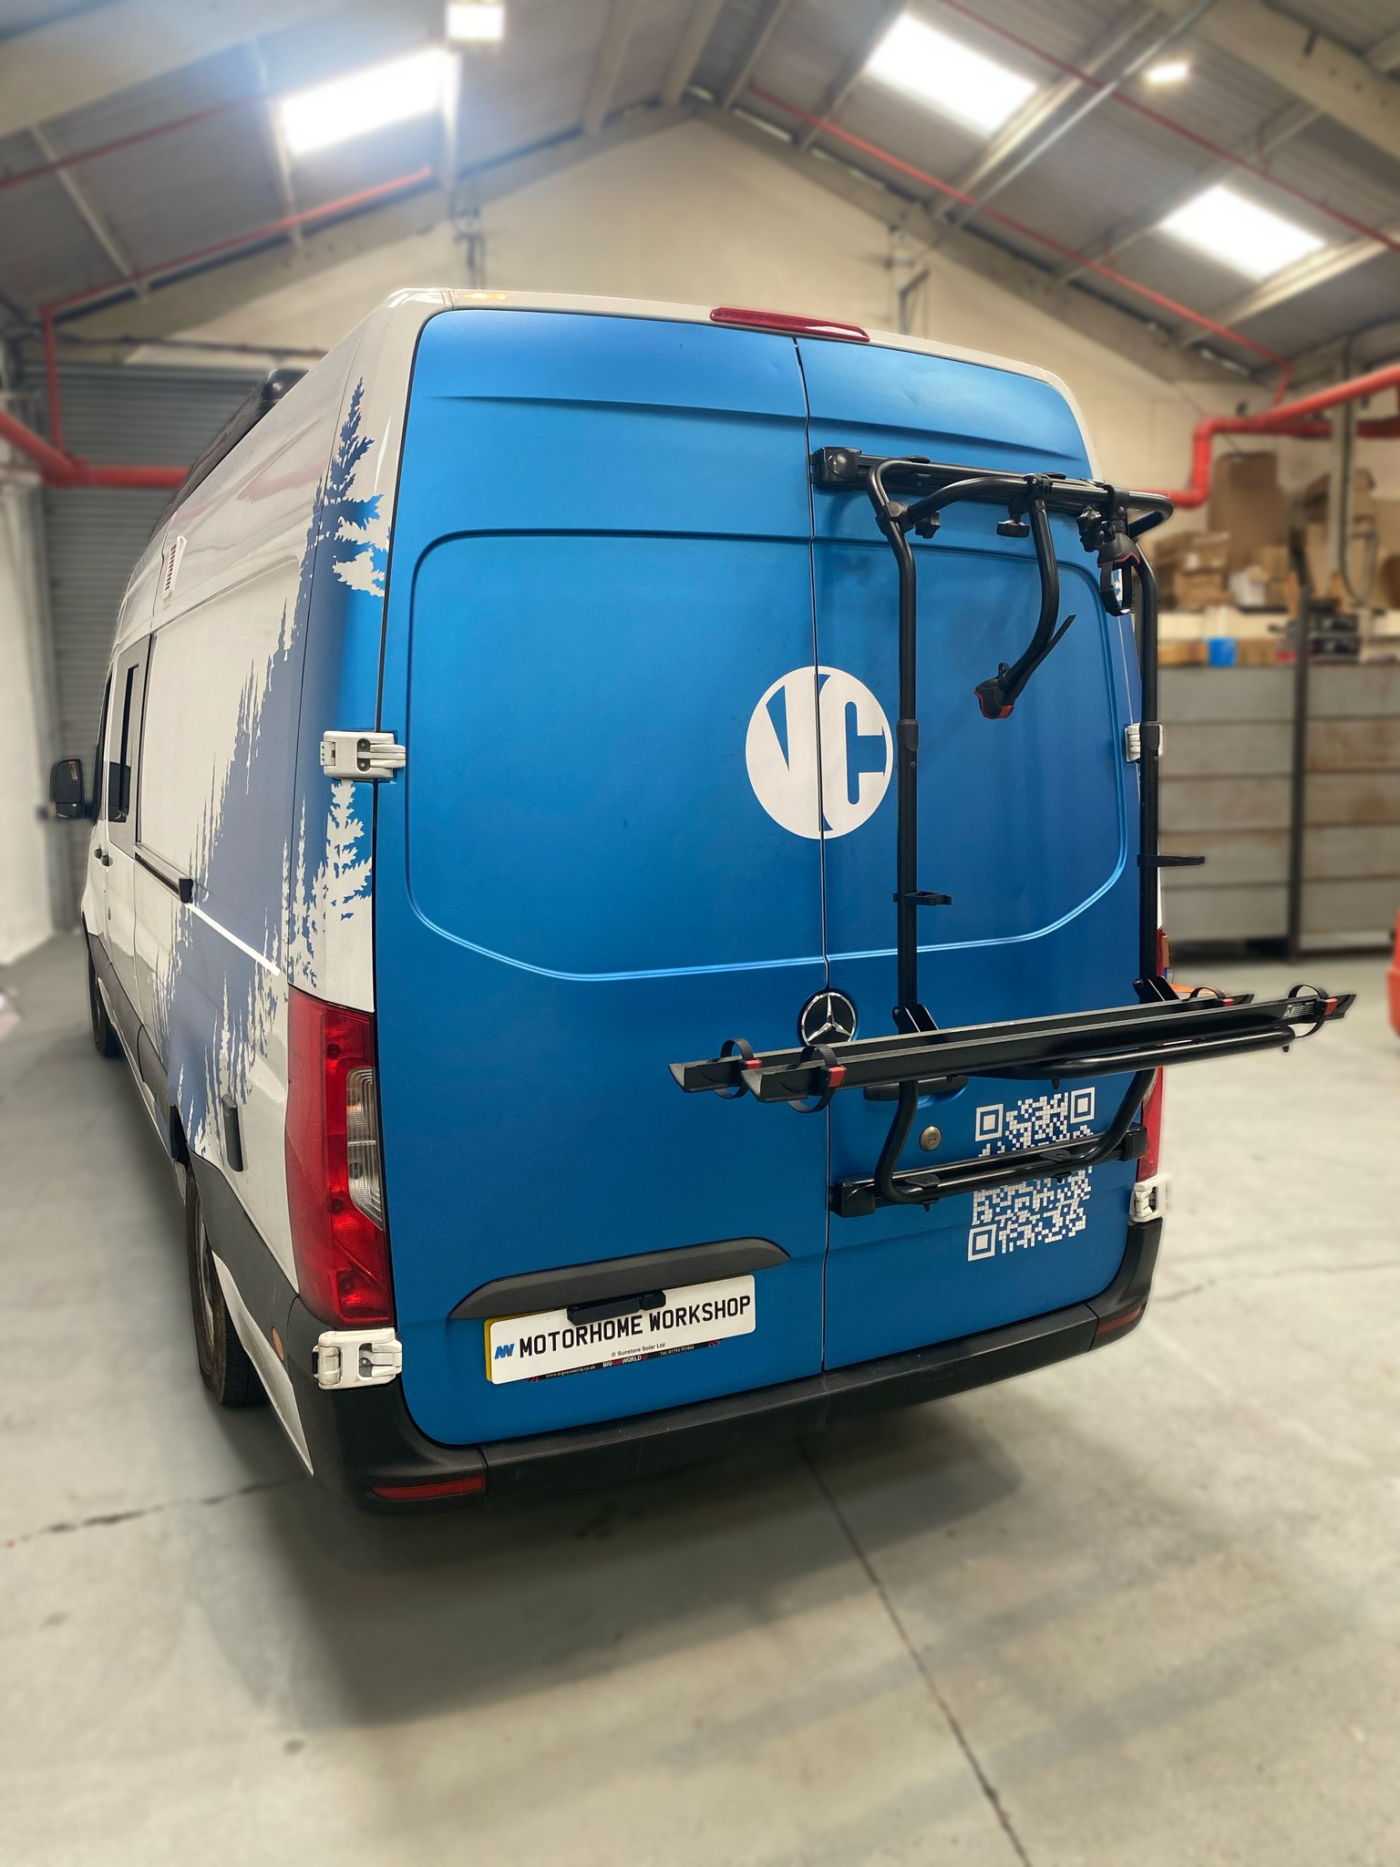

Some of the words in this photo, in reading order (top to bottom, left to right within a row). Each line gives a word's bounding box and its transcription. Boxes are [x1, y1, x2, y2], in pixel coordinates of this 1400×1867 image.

[519, 1315, 643, 1358] MOTORHOME
[649, 1295, 751, 1332] WORKSHOP
[617, 1347, 641, 1356] Sunstore
[642, 1344, 656, 1352] Solar
